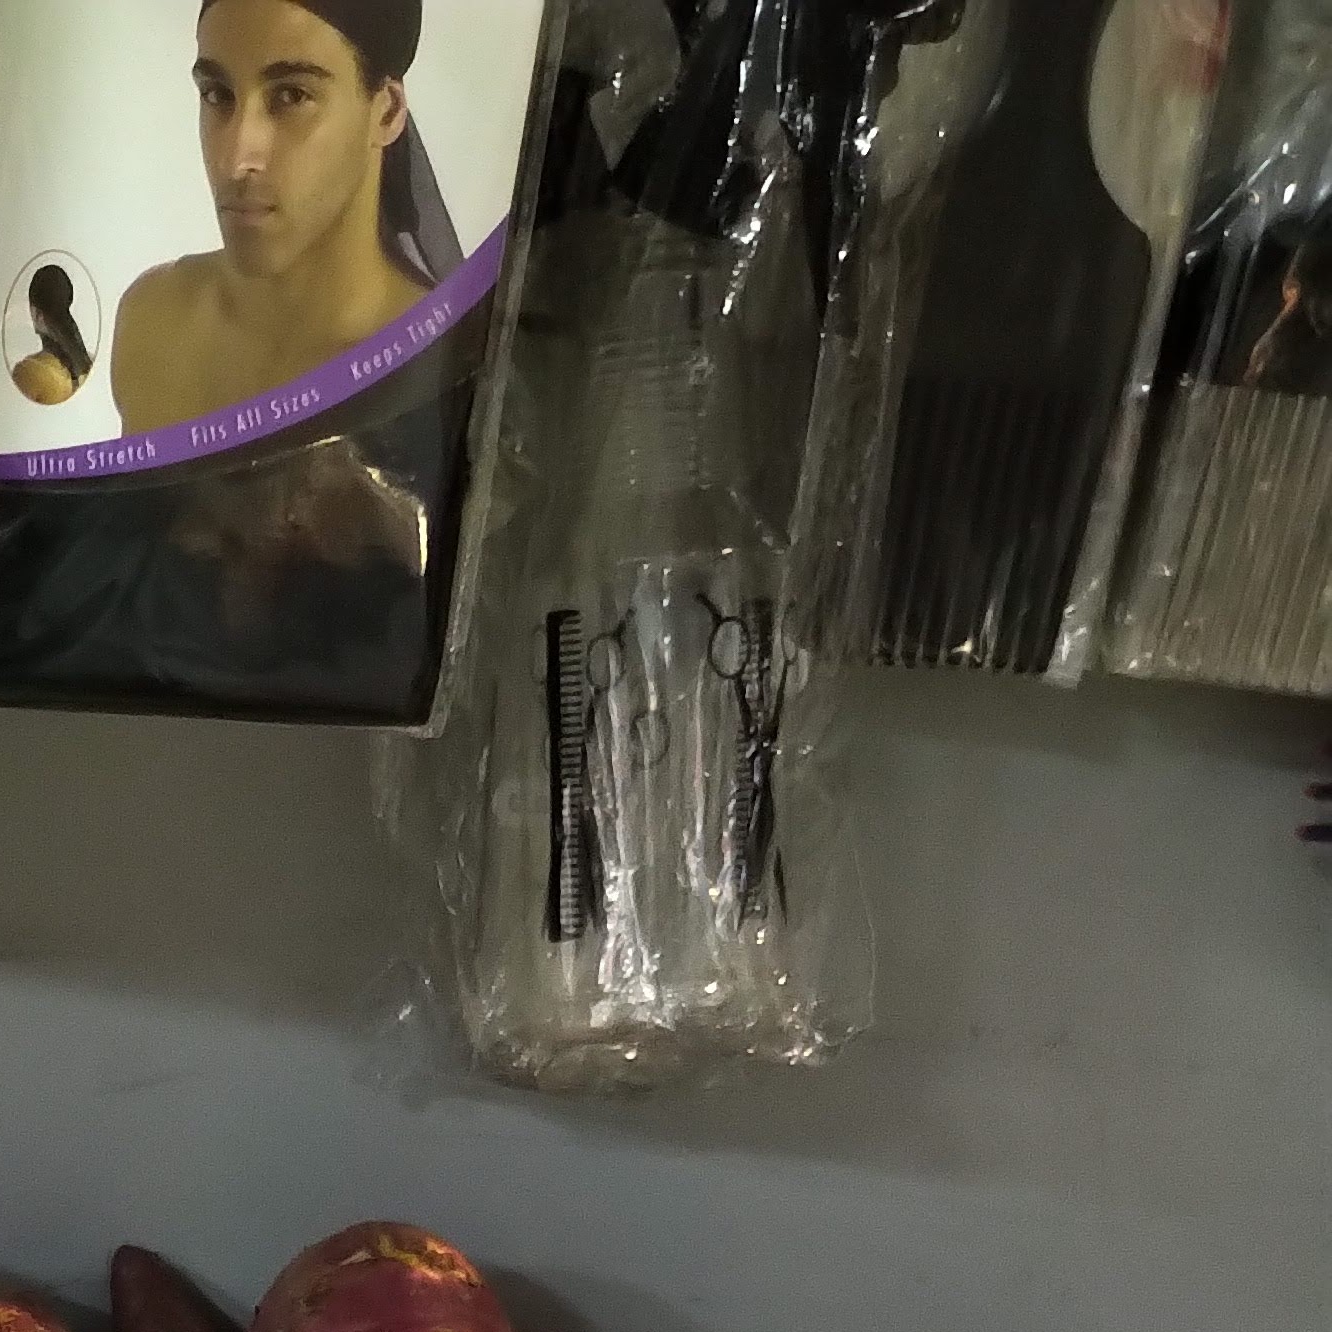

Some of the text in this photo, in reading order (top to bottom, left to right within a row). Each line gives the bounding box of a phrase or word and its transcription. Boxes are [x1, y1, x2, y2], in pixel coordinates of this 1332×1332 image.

[349, 301, 452, 381] Keeps Tight
[190, 387, 321, 448] Fits All Sizes
[27, 436, 156, 477] Ultra Stretch
